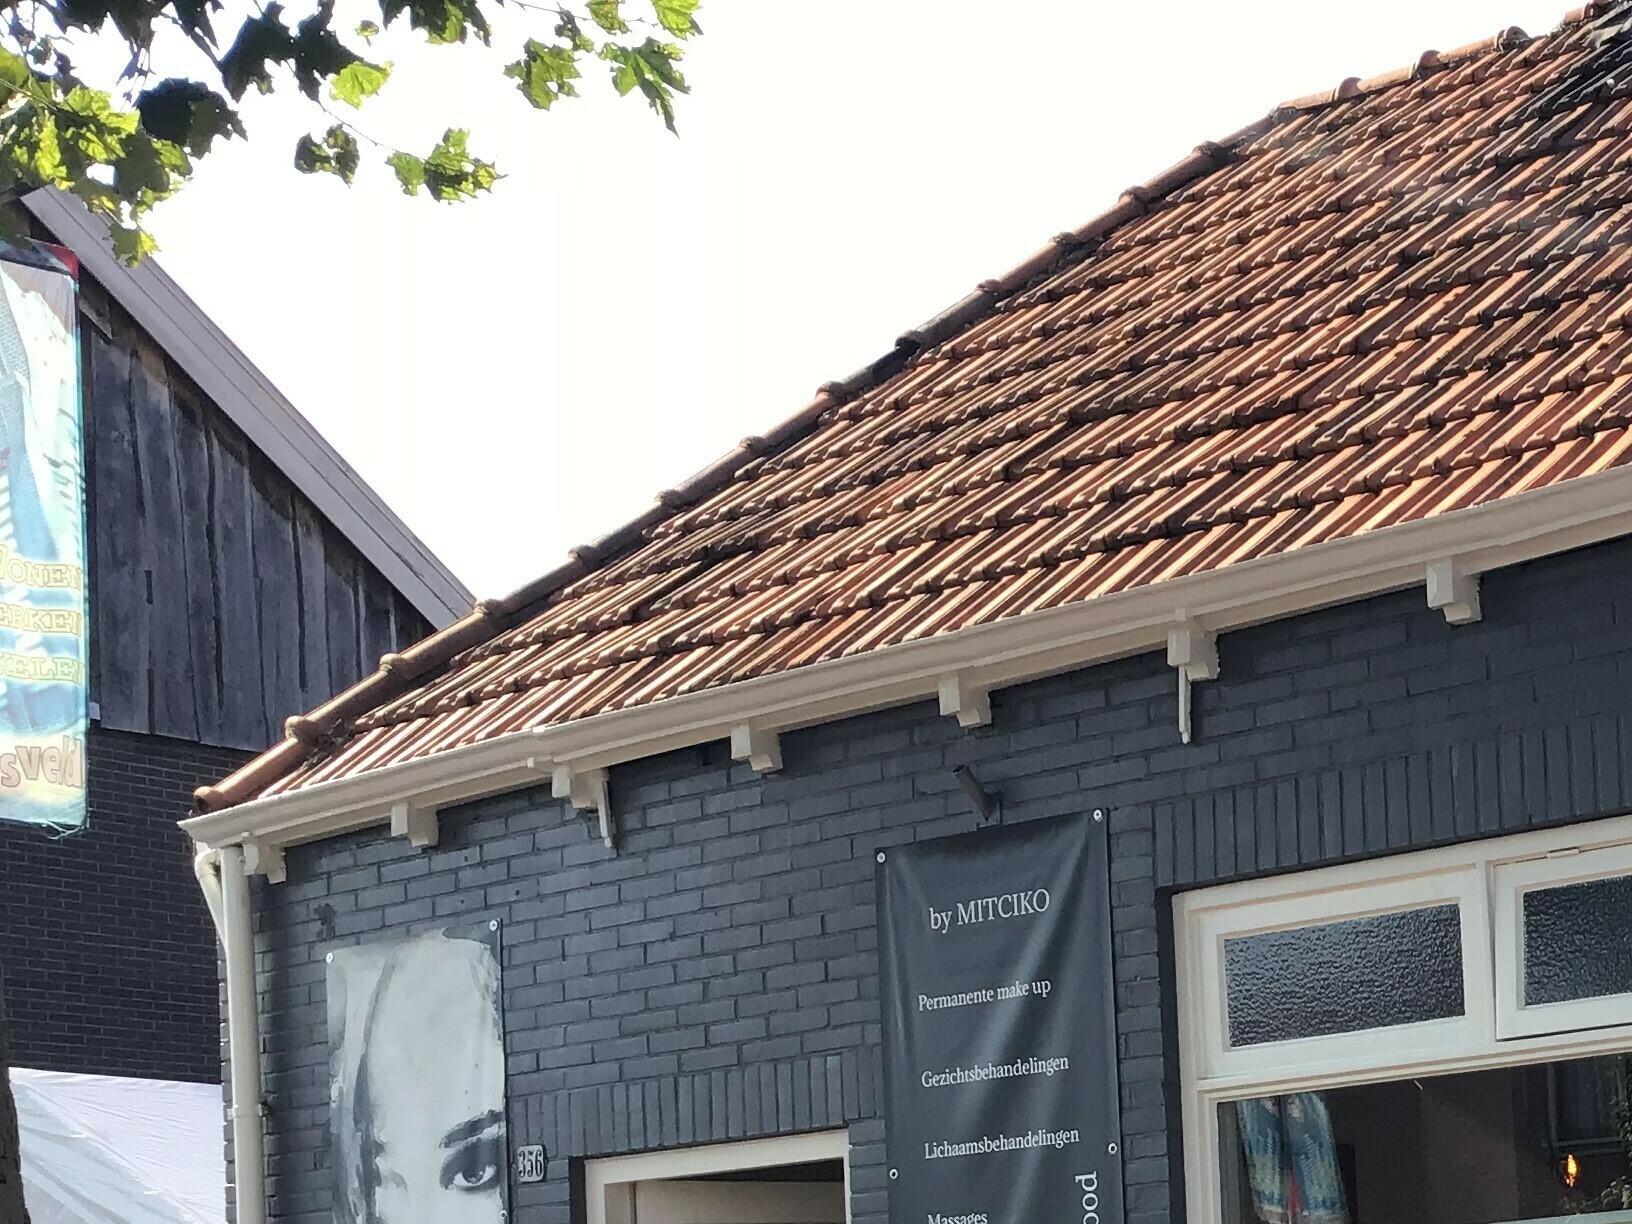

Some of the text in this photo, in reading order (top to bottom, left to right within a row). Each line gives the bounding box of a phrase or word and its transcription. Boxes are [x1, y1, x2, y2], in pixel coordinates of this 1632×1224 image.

[929, 888, 1051, 933] by MITCIKO
[917, 978, 1052, 1012] Permanente make up
[921, 1054, 1070, 1089] Gezichtsbehandelingen
[924, 1127, 1080, 1160] Lichaamsbehandelingen
[518, 1148, 543, 1178] 356
